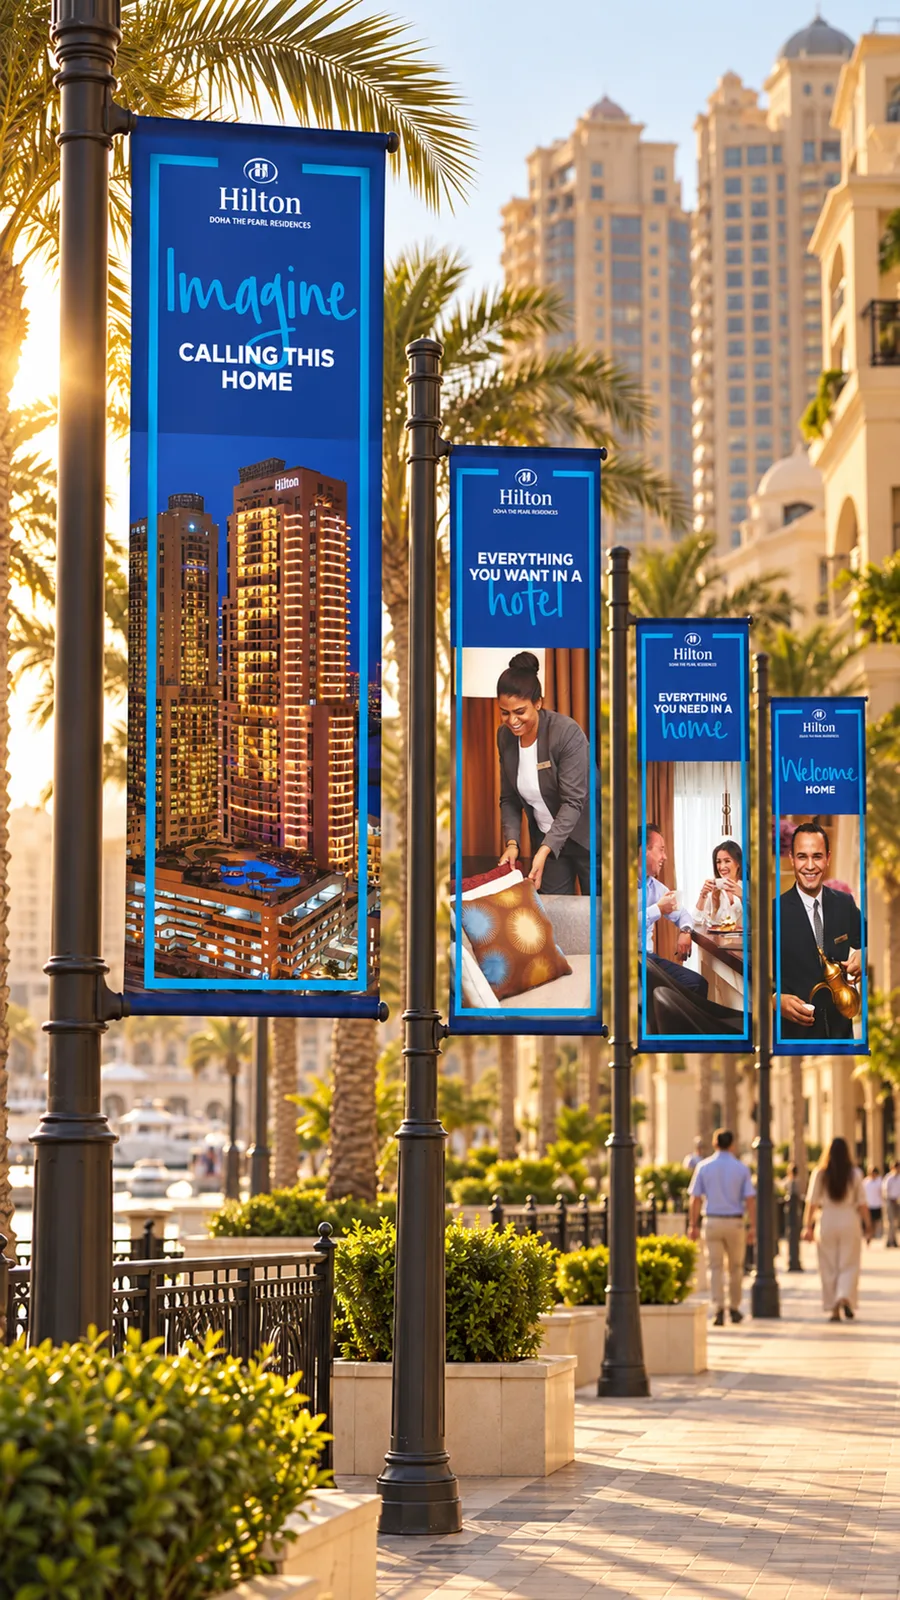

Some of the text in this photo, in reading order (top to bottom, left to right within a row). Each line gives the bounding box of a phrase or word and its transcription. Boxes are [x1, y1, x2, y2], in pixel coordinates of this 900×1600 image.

[219, 186, 302, 215] Hilton
[209, 215, 312, 229] DOHA THE PEARL RESIDENCES
[167, 247, 357, 371] Imagine
[178, 342, 335, 368] CALLING THIS
[221, 370, 293, 391] HOME
[275, 477, 299, 491] Hilton
[500, 488, 553, 506] Hilton
[477, 551, 574, 566] EVERYTHING
[469, 568, 583, 583] YOU WANT IN A
[488, 576, 563, 626] hotel
[673, 648, 713, 661] Hilton
[658, 692, 728, 702] EVERYTHING
[653, 704, 733, 714] YOU NEED IN A
[661, 713, 728, 739] home
[803, 722, 836, 732] Hilton
[781, 756, 858, 783] Welcome
[805, 786, 836, 795] HOME
